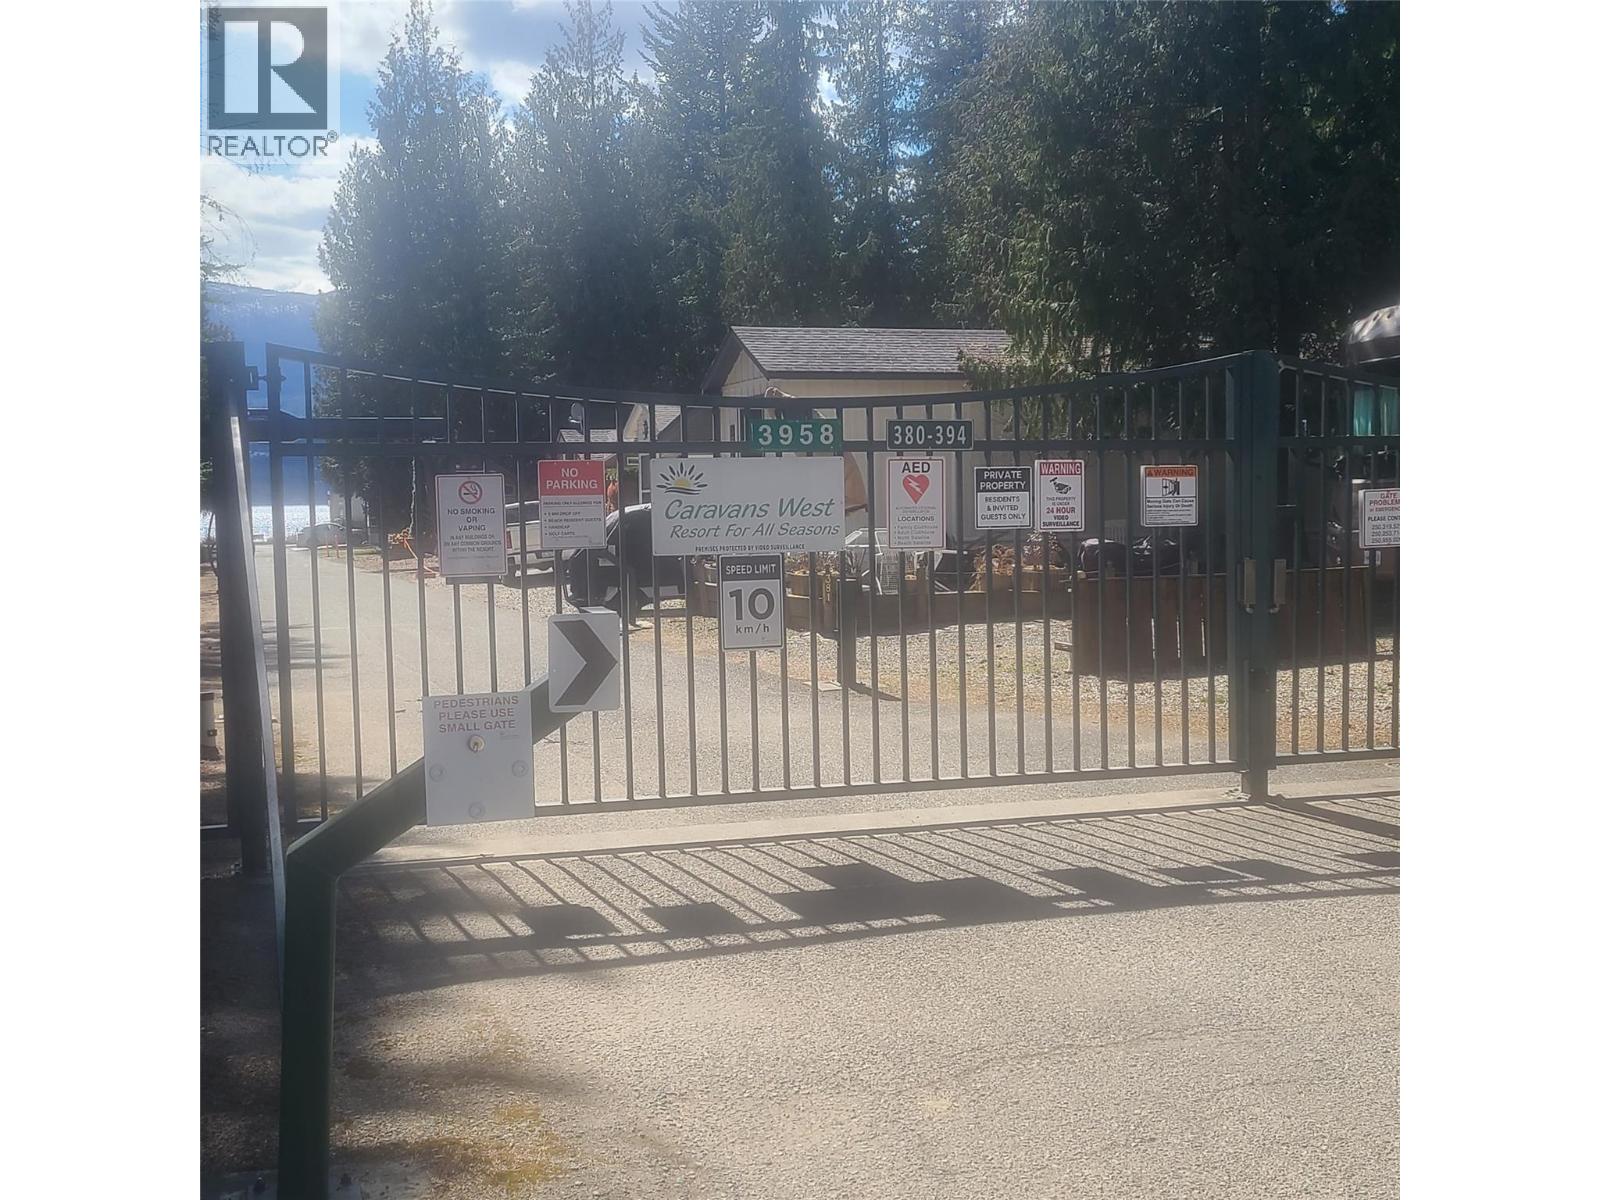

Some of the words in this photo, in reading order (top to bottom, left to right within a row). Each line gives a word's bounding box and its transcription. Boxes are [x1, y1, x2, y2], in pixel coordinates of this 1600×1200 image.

[758, 424, 834, 446] 3958
[894, 426, 966, 444] 380-394
[561, 468, 578, 478] NO
[902, 462, 930, 474] AED
[1041, 463, 1080, 474] WARNING
[984, 471, 1022, 479] PRIVATE
[546, 480, 598, 489] PARKING
[980, 482, 1026, 490] PROPERTY
[664, 499, 770, 520] Caravans
[778, 497, 836, 517] West
[670, 524, 721, 539] Resort
[725, 524, 750, 538] For
[752, 523, 776, 536] All
[778, 522, 840, 536] Seasons
[726, 565, 752, 575] SPEED
[754, 564, 776, 574] LIMIT
[728, 588, 774, 620] 10
[736, 624, 769, 634] km/h
[434, 696, 518, 708] PEDESTRIANS
[439, 709, 486, 720] PLEASE
[490, 708, 514, 717] USE
[440, 723, 480, 733] SMALL
[484, 720, 516, 730] GATE
